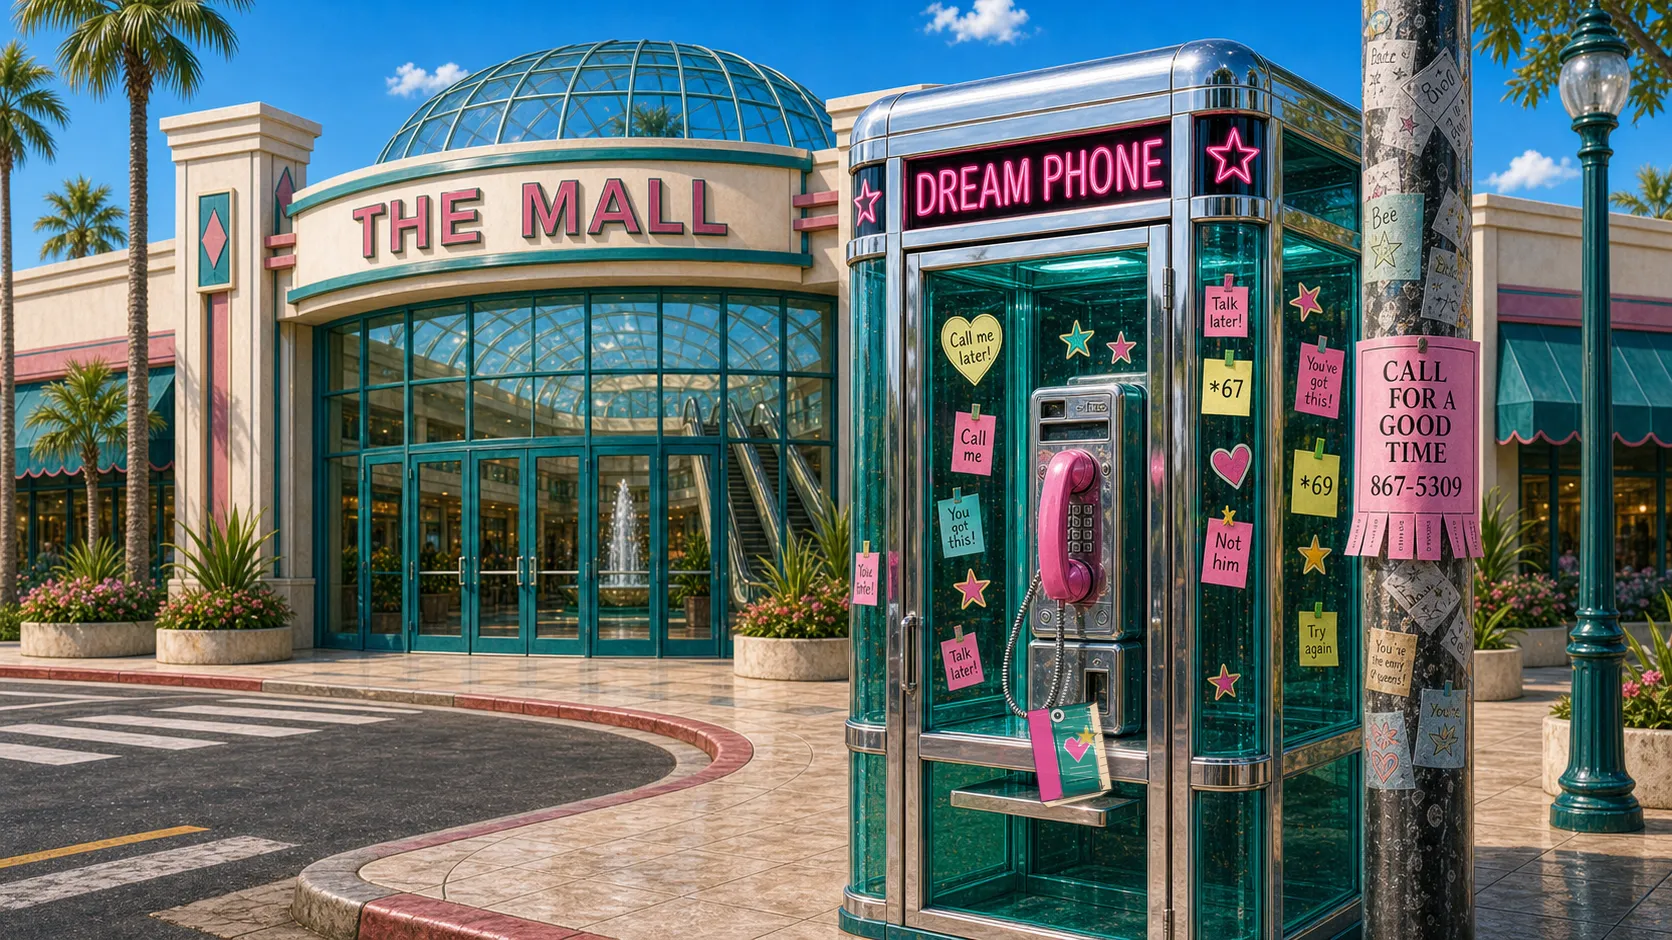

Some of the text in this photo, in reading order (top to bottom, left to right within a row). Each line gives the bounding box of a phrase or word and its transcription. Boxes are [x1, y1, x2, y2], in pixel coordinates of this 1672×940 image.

[916, 138, 1164, 217] DREAM PHONE
[353, 178, 728, 258] THE MALL
[1372, 206, 1399, 230] Bee
[1211, 296, 1239, 311] Talk
[1210, 313, 1242, 329] later!
[950, 329, 995, 348] Call me
[958, 345, 992, 366] later!
[1306, 355, 1338, 375] You've
[1383, 360, 1448, 383] CALL
[1310, 376, 1329, 391] got
[1304, 391, 1333, 409] this!
[1389, 387, 1457, 411] FOR A
[1379, 414, 1452, 437] GOOD
[960, 428, 987, 446] Call
[963, 450, 982, 463] me
[1385, 441, 1448, 464] TIME
[1370, 474, 1463, 498] 867-5309
[948, 505, 970, 522] You
[951, 521, 969, 536] got
[947, 530, 976, 549] this!
[1215, 532, 1242, 551] Not
[1212, 553, 1240, 573] him
[1307, 624, 1326, 641] Try
[949, 647, 973, 664] Talk
[1304, 642, 1332, 660] again
[950, 660, 978, 681] later!
